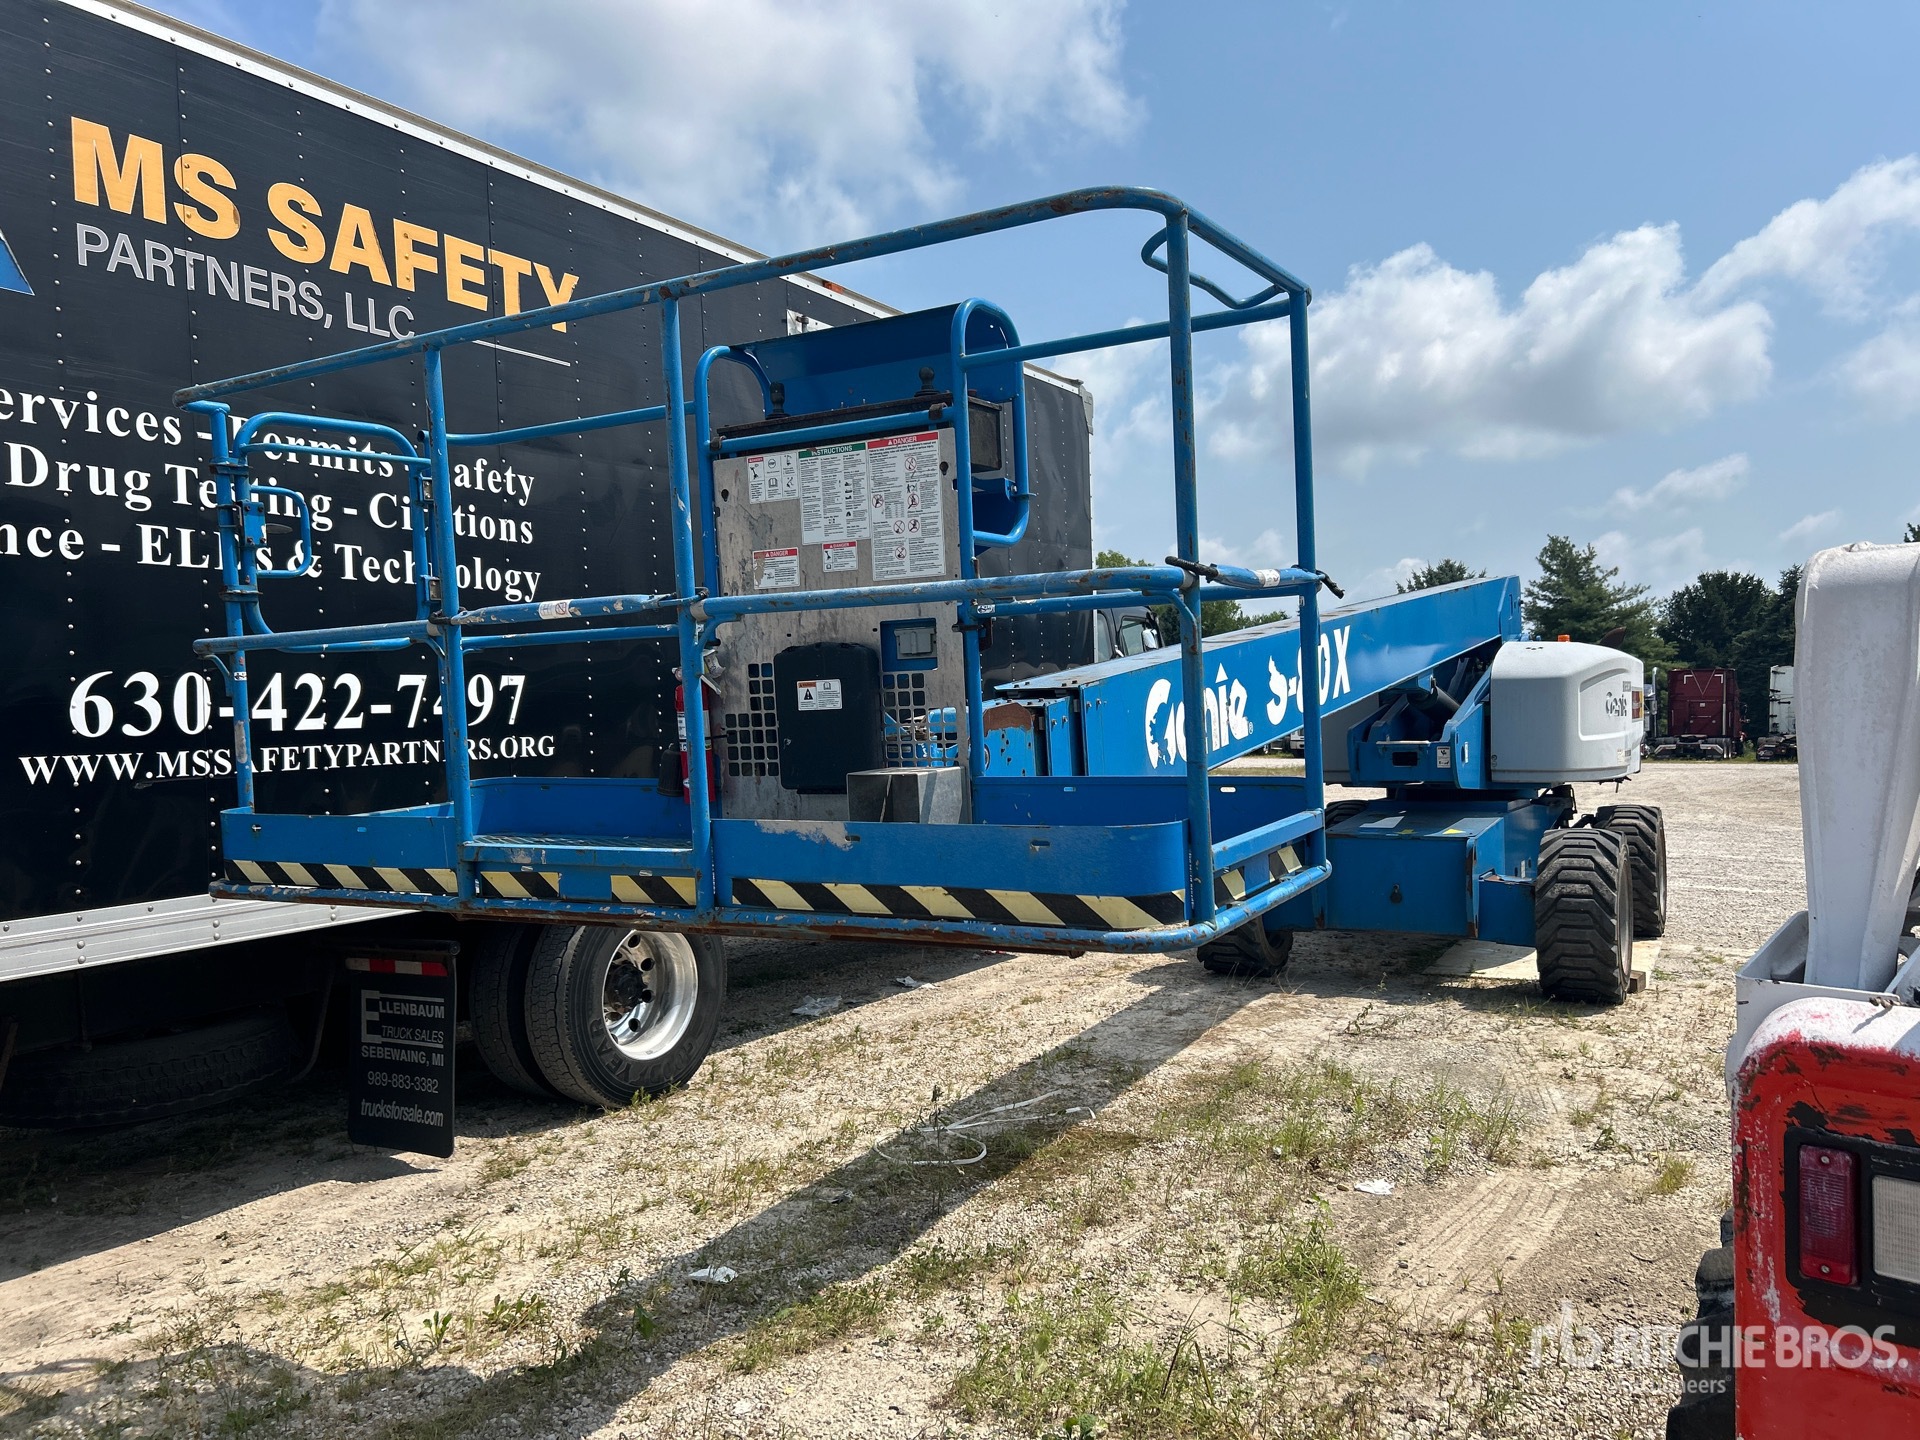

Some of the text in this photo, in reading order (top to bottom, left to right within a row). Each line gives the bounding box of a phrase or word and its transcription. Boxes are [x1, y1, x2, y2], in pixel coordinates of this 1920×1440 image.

[71, 116, 579, 333] MS SAFETY
[76, 223, 415, 341] PARTNERS, LLC
[892, 436, 918, 445] DANGER
[4, 441, 152, 512] Drug
[165, 463, 333, 532] Teting
[369, 492, 534, 545] Citions
[454, 458, 534, 507] afety
[287, 540, 323, 578] &
[334, 543, 541, 603] Techology
[19, 735, 556, 785] WWW.MSSFETYPARTNRS.ORG
[361, 1045, 444, 1067] SEBEWAING, MI
[381, 1025, 444, 1044] TRUCK SALES
[367, 1071, 439, 1094] 989-883-3382
[361, 1098, 444, 1127] trucksforsale.com
